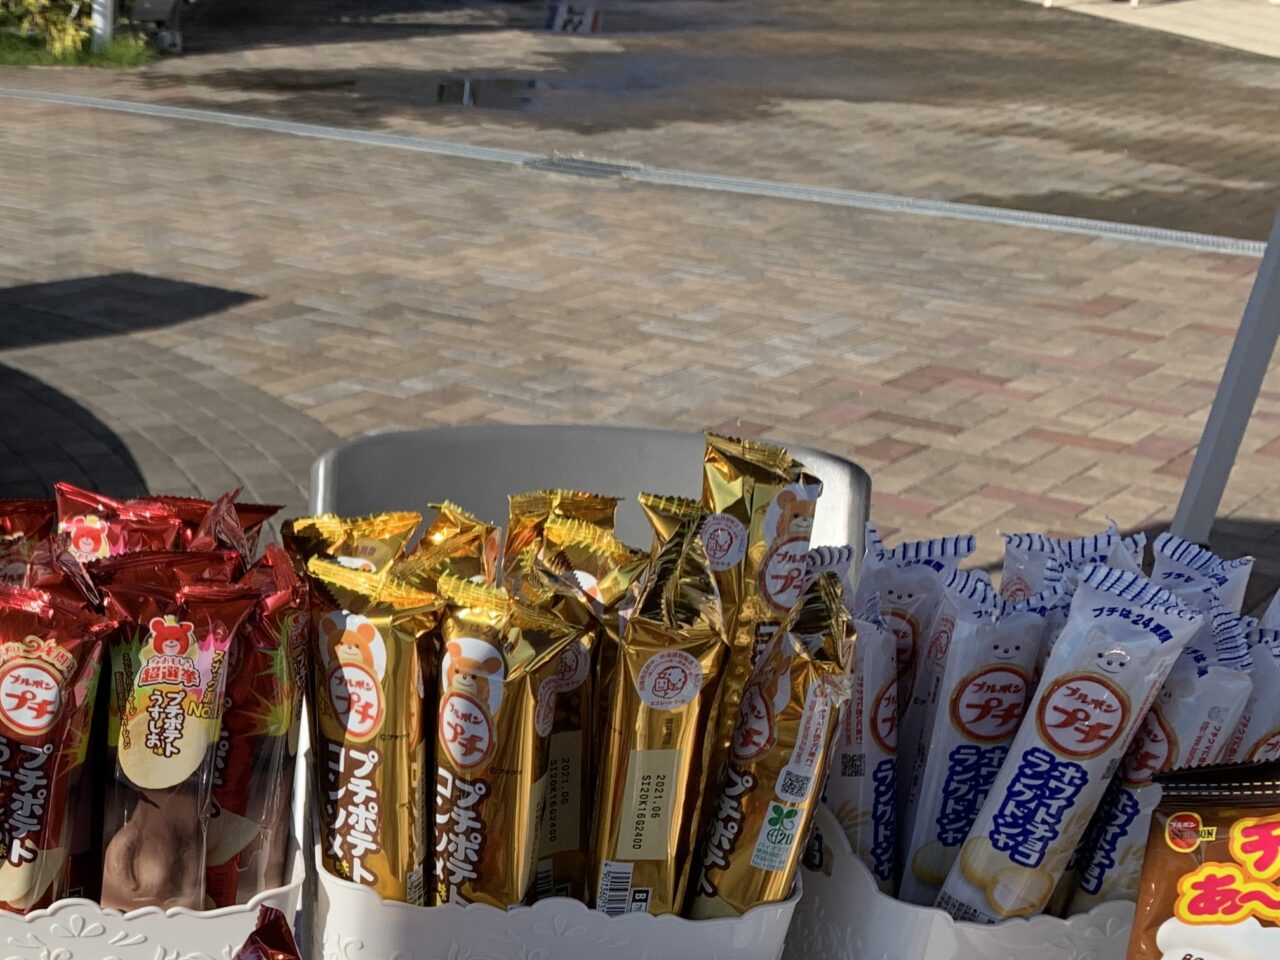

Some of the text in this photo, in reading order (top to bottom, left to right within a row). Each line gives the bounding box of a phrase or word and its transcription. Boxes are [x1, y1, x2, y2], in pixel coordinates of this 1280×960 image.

[8, 673, 56, 692] ブルボン
[332, 675, 374, 692] ブルボン
[971, 681, 1025, 695] ブルボン
[1062, 685, 1120, 714] ブルボン
[4, 689, 56, 721] プチ
[334, 690, 375, 724] プチ
[448, 702, 485, 725] ブルボン
[965, 696, 1022, 727] プチ
[163, 691, 187, 758] プチポテト
[446, 719, 485, 756] プチ
[1046, 704, 1114, 745] プチ
[7, 742, 55, 866] プチポテト
[650, 774, 667, 820] 2021.06
[992, 750, 1057, 850] ラングドシャ
[1013, 761, 1084, 866] ホワイトチョコ
[346, 749, 380, 886] プチポテト
